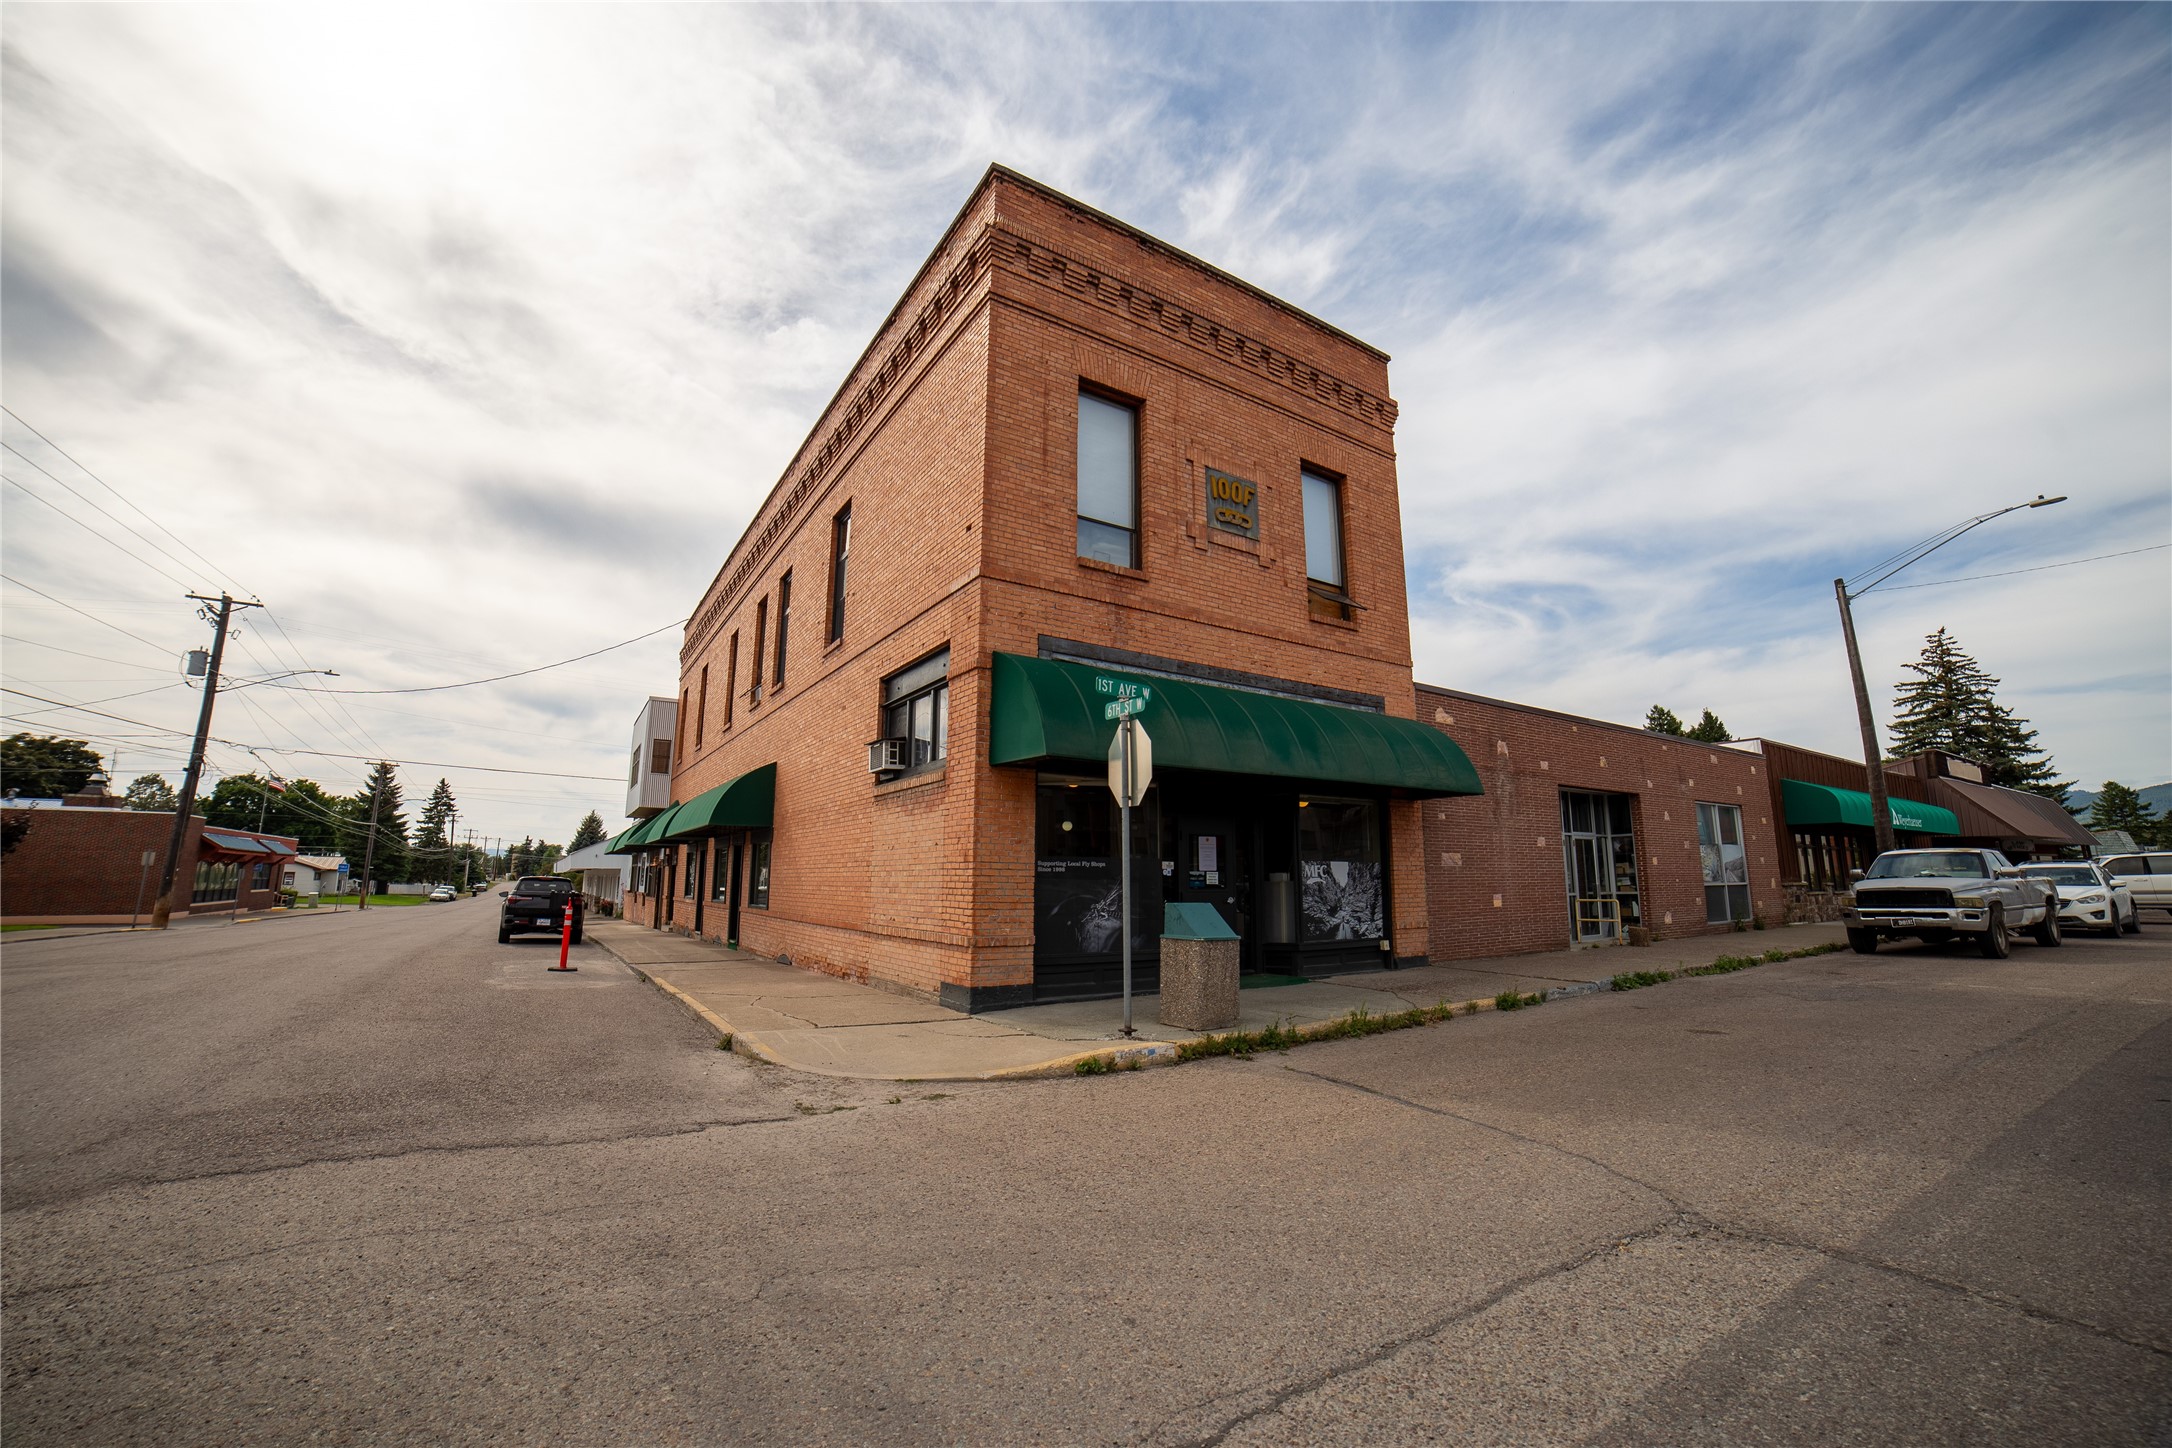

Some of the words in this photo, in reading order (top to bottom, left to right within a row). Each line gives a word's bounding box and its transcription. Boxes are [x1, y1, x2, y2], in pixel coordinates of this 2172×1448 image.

[1210, 475, 1255, 507] IOOF
[1098, 678, 1114, 693] 1ST
[1118, 683, 1137, 697] AVE
[1142, 687, 1150, 700] W
[1107, 703, 1120, 718] 6TH
[1124, 699, 1133, 713] ST
[1136, 696, 1143, 710] W
[1304, 865, 1328, 878] MFC
